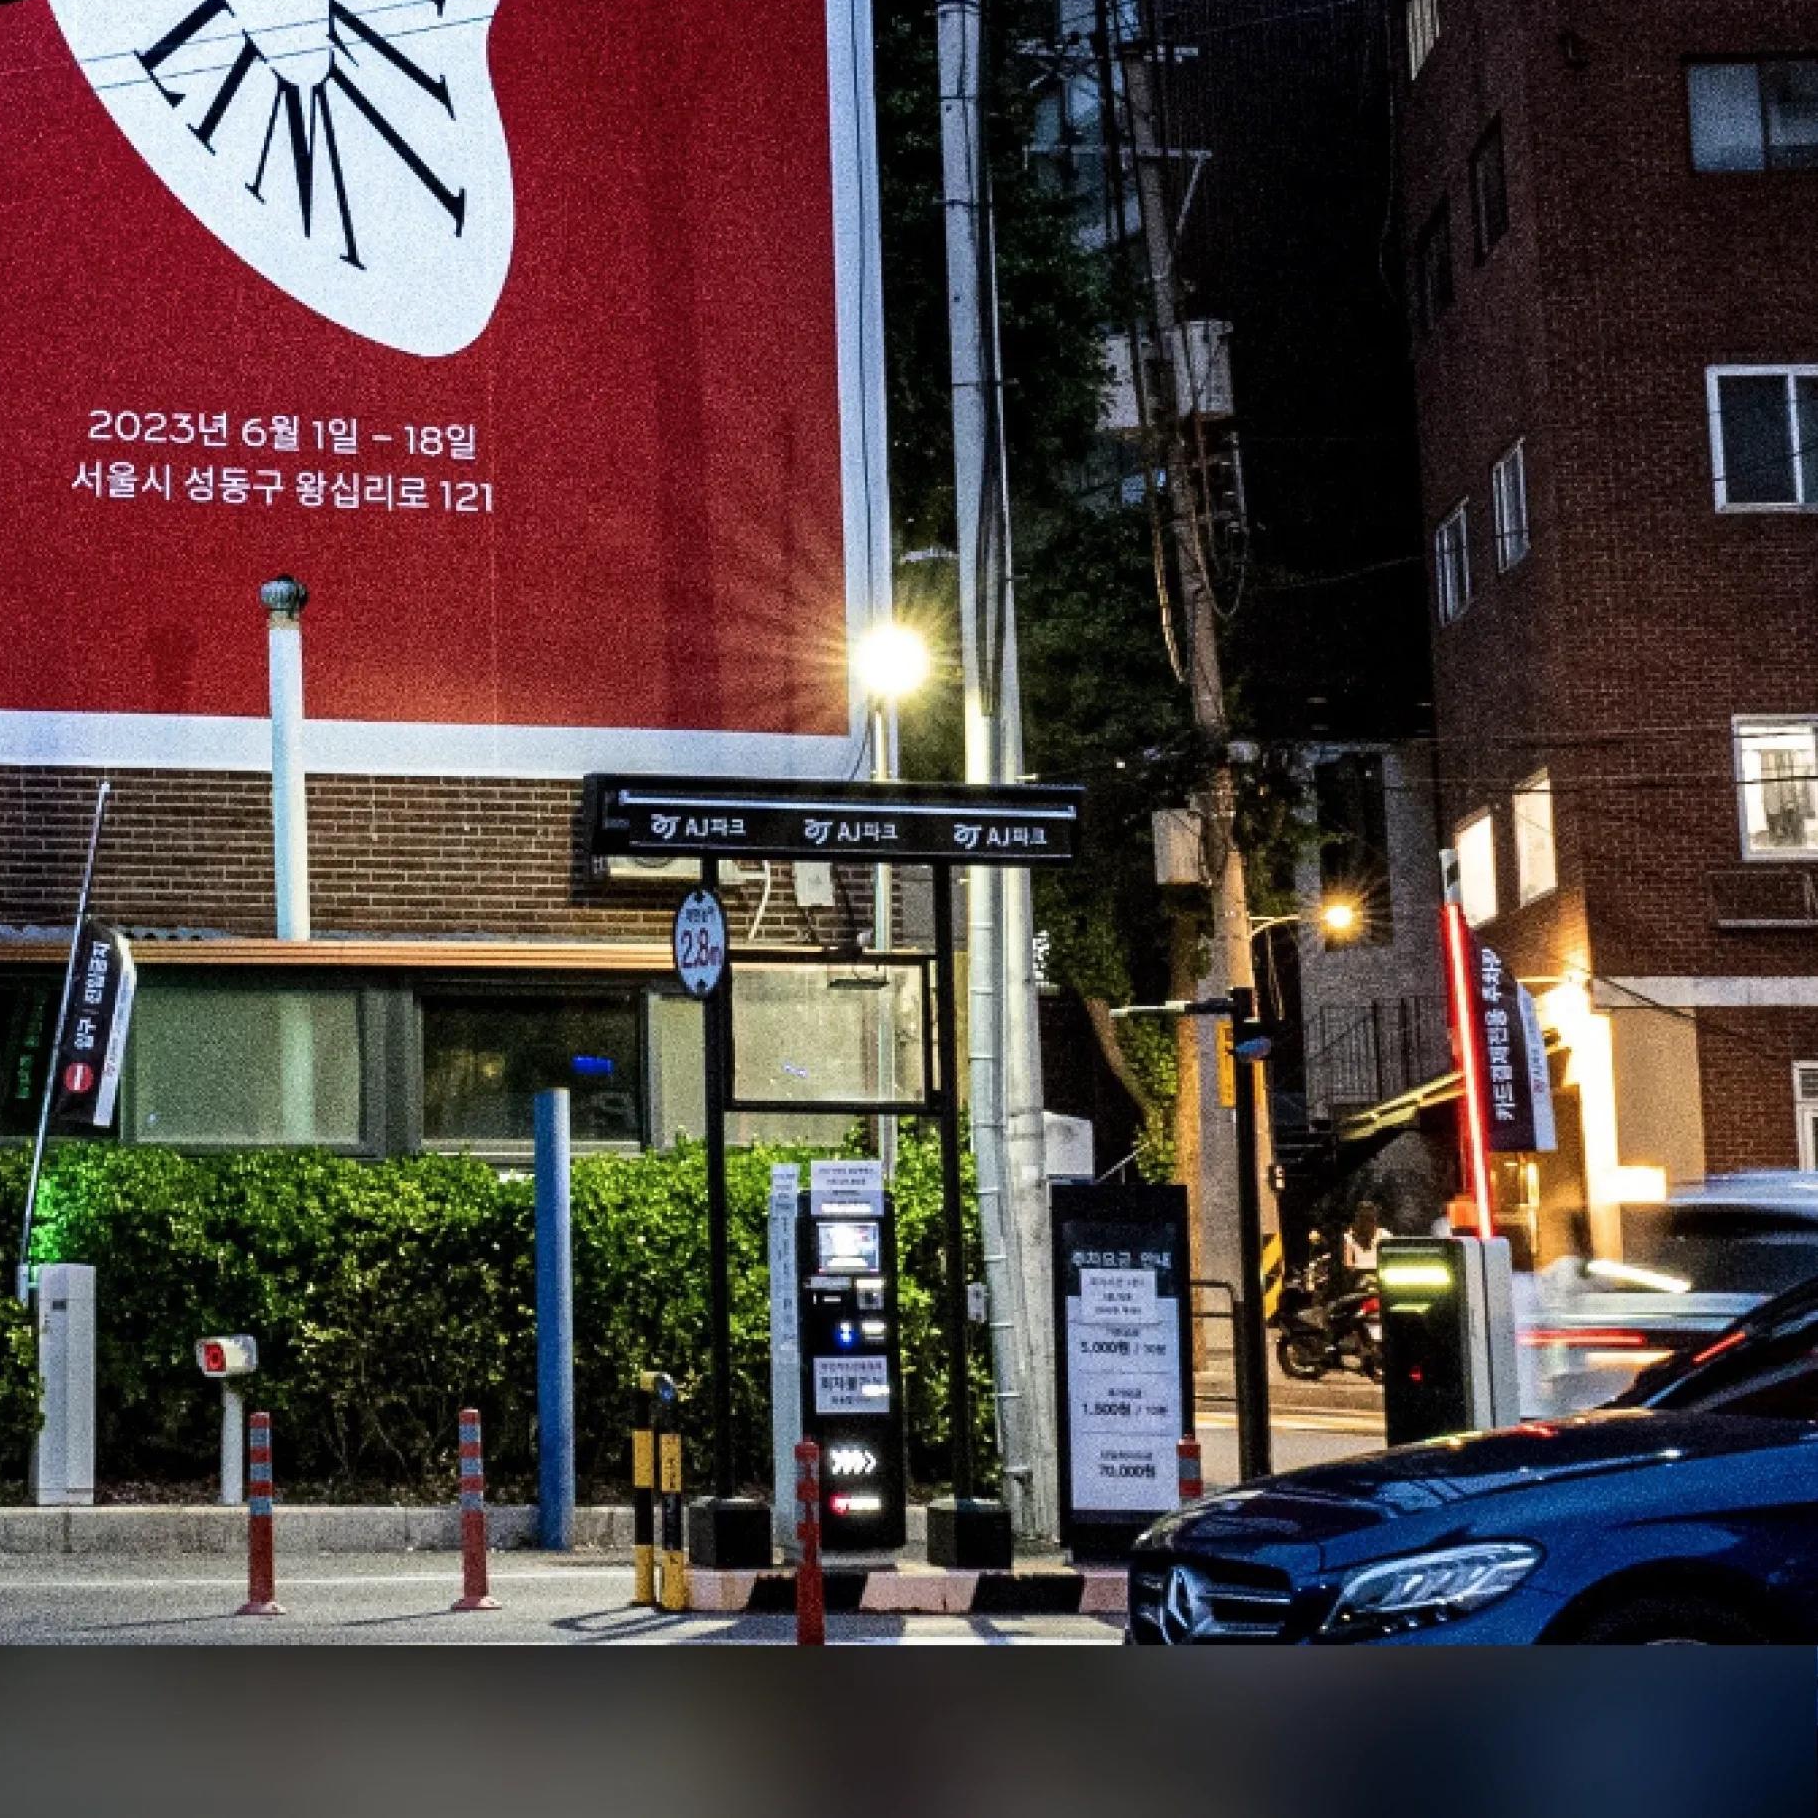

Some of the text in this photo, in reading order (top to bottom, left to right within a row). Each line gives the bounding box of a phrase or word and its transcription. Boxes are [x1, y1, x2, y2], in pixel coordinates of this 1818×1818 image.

[88, 409, 228, 447] 2023년
[241, 415, 300, 452] 6월
[312, 418, 358, 455] 1일
[404, 423, 477, 460] 18일
[71, 461, 494, 512] 서울시 성동구 왕십리로 121
